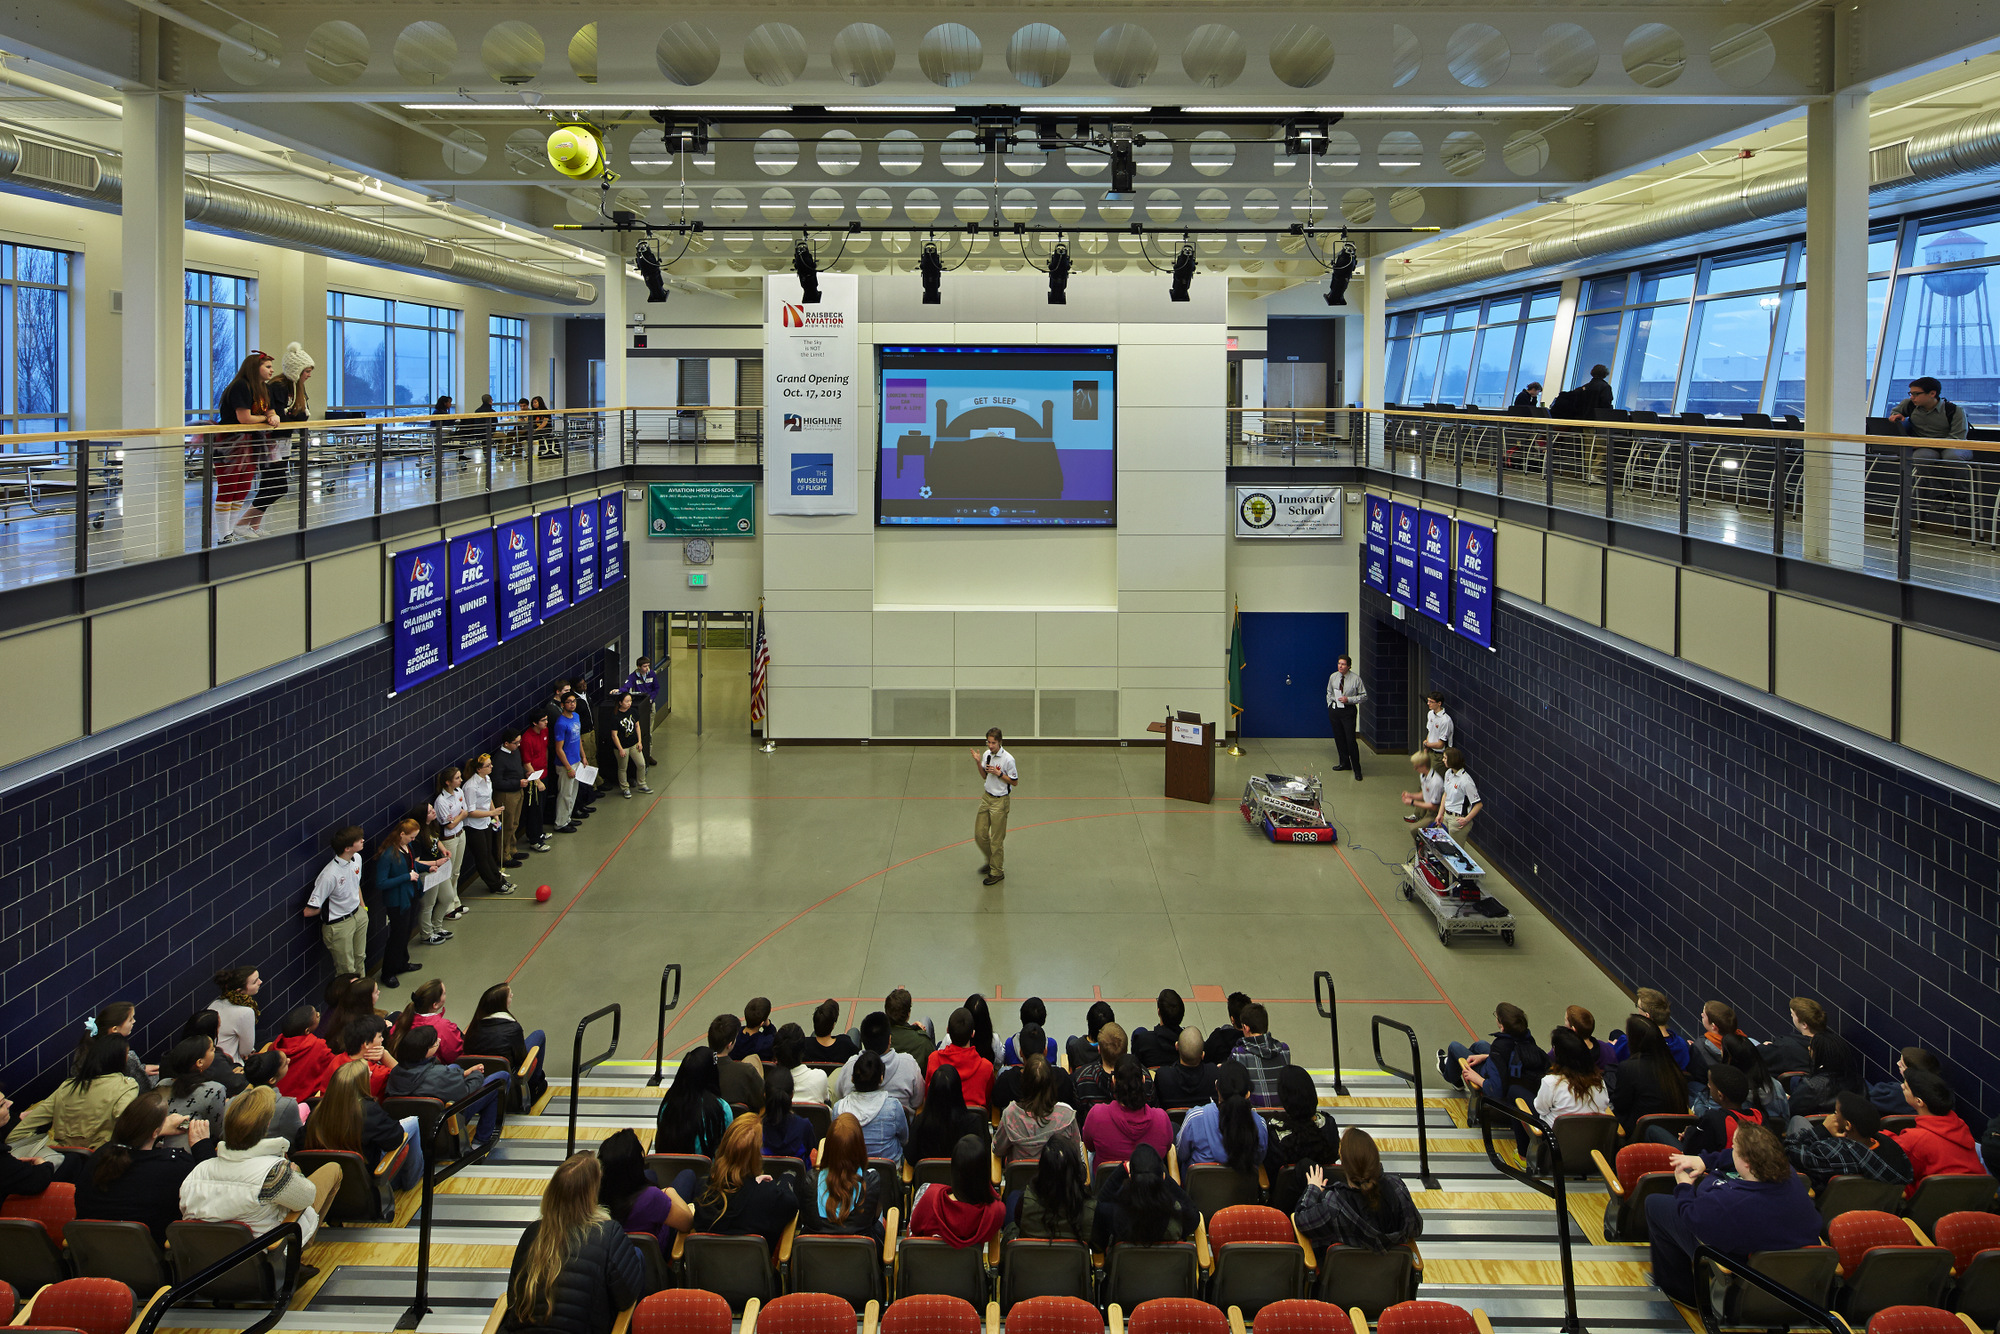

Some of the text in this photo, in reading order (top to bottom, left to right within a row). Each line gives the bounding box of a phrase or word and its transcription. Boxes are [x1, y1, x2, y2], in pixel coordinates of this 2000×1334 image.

[776, 374, 849, 385] Grand Opening
[783, 389, 842, 399] Oct. 17, 2013
[974, 397, 1016, 405] GET SLEEP
[1278, 495, 1335, 503] Innovative
[1289, 506, 1324, 515] School
[582, 527, 593, 535] FIRST
[1371, 521, 1383, 534] FRC
[552, 536, 563, 545] FIRST
[1398, 531, 1411, 544] FRC
[1370, 544, 1384, 556] WINNER
[1426, 540, 1441, 554] FRC
[515, 549, 528, 559] FIRST
[512, 560, 530, 572] ROBOTICS
[1396, 555, 1413, 568] WINNER
[1464, 554, 1481, 571] FRC
[462, 565, 483, 585] FRC
[692, 575, 704, 584] EXIT
[1424, 566, 1442, 580] WINNER
[508, 574, 536, 591] CHAIRMAN'S
[1460, 577, 1486, 594] CHAIRMAN'S
[409, 582, 433, 603] FRC
[514, 583, 531, 596] AWARD
[1464, 587, 1480, 599] AWARD
[459, 595, 487, 614] WINNER
[508, 601, 535, 618] MICROSOFT
[404, 608, 442, 629] CHAIRMAN'S
[512, 610, 531, 623] SEATTLE
[1464, 615, 1480, 628] SEATTLE
[411, 620, 433, 635] AWARD
[511, 616, 532, 631] REGIONAL
[1463, 621, 1481, 635] REGIONAL
[461, 625, 487, 642] SPOKANE
[461, 632, 488, 650] REGIONAL
[415, 644, 430, 655] 2012
[408, 648, 438, 666] SPOKANE
[406, 656, 439, 675] REGIONAL
[1292, 832, 1318, 842] 1983
